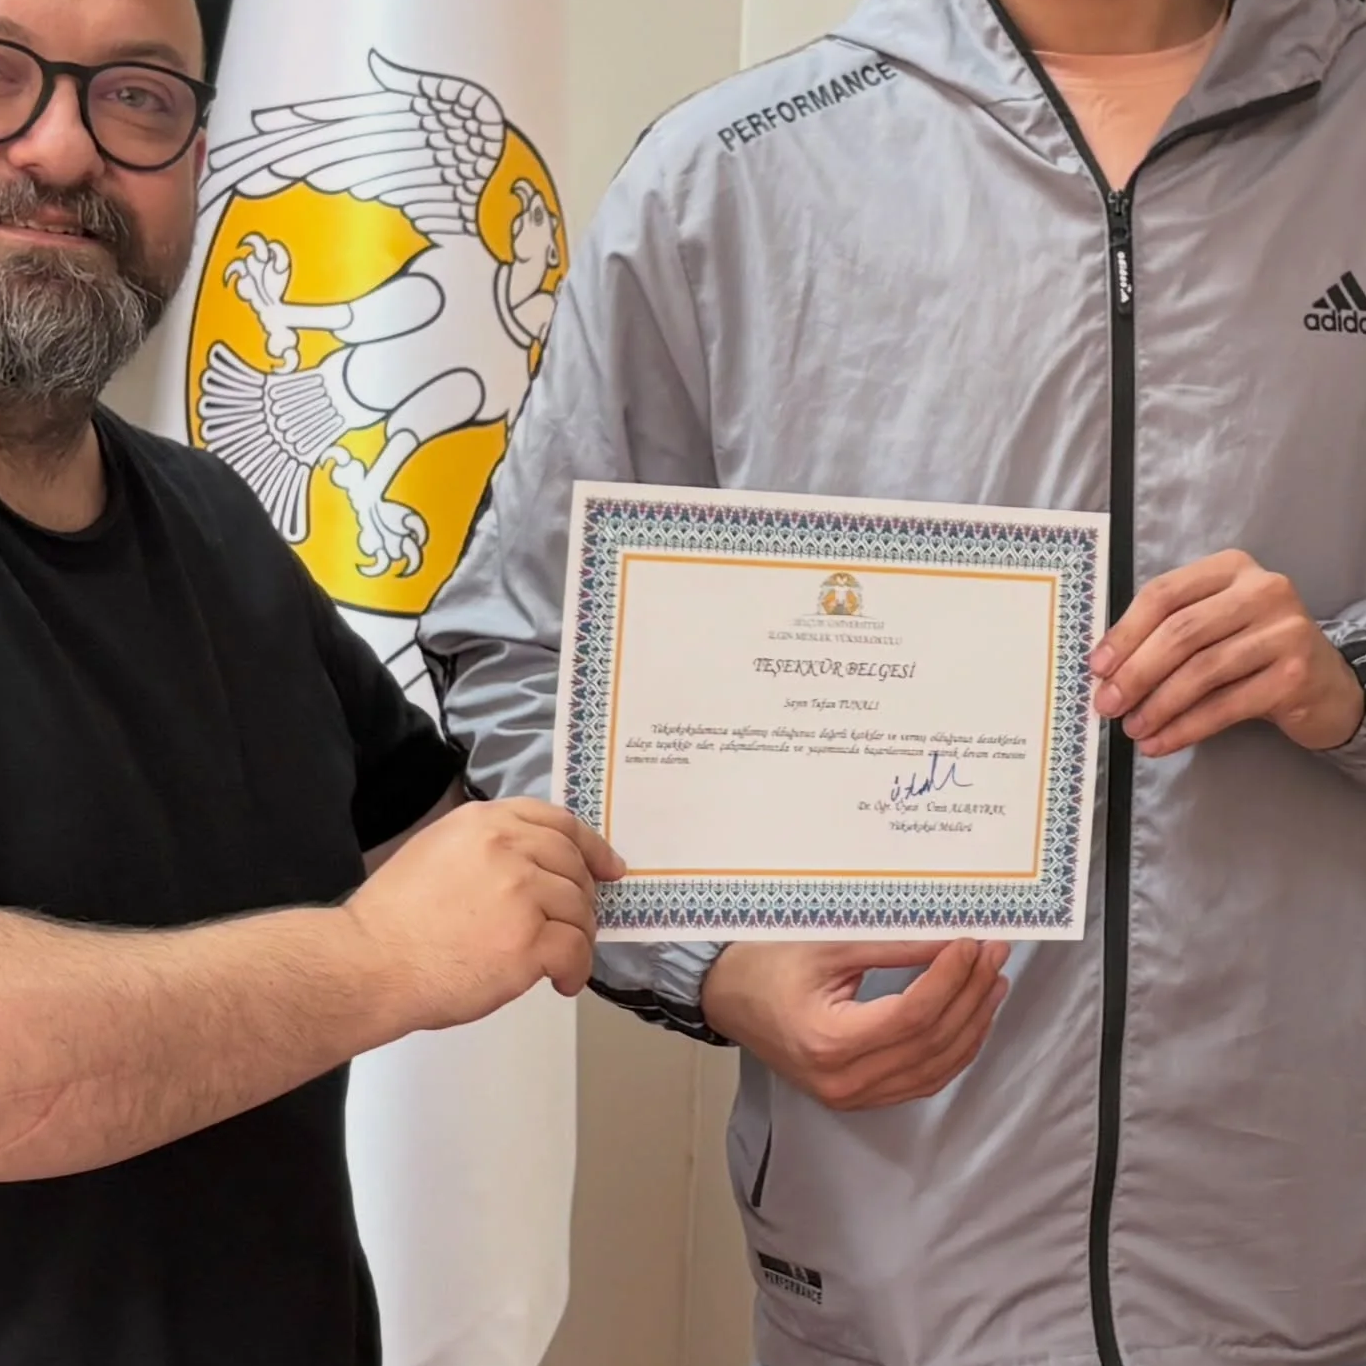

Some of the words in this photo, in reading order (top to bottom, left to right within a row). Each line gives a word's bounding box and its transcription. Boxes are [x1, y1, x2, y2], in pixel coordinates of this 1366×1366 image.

[717, 61, 897, 153] PERFORMANCE
[752, 657, 844, 678] TEŞEKKÜR
[845, 661, 917, 682] BELGESİ
